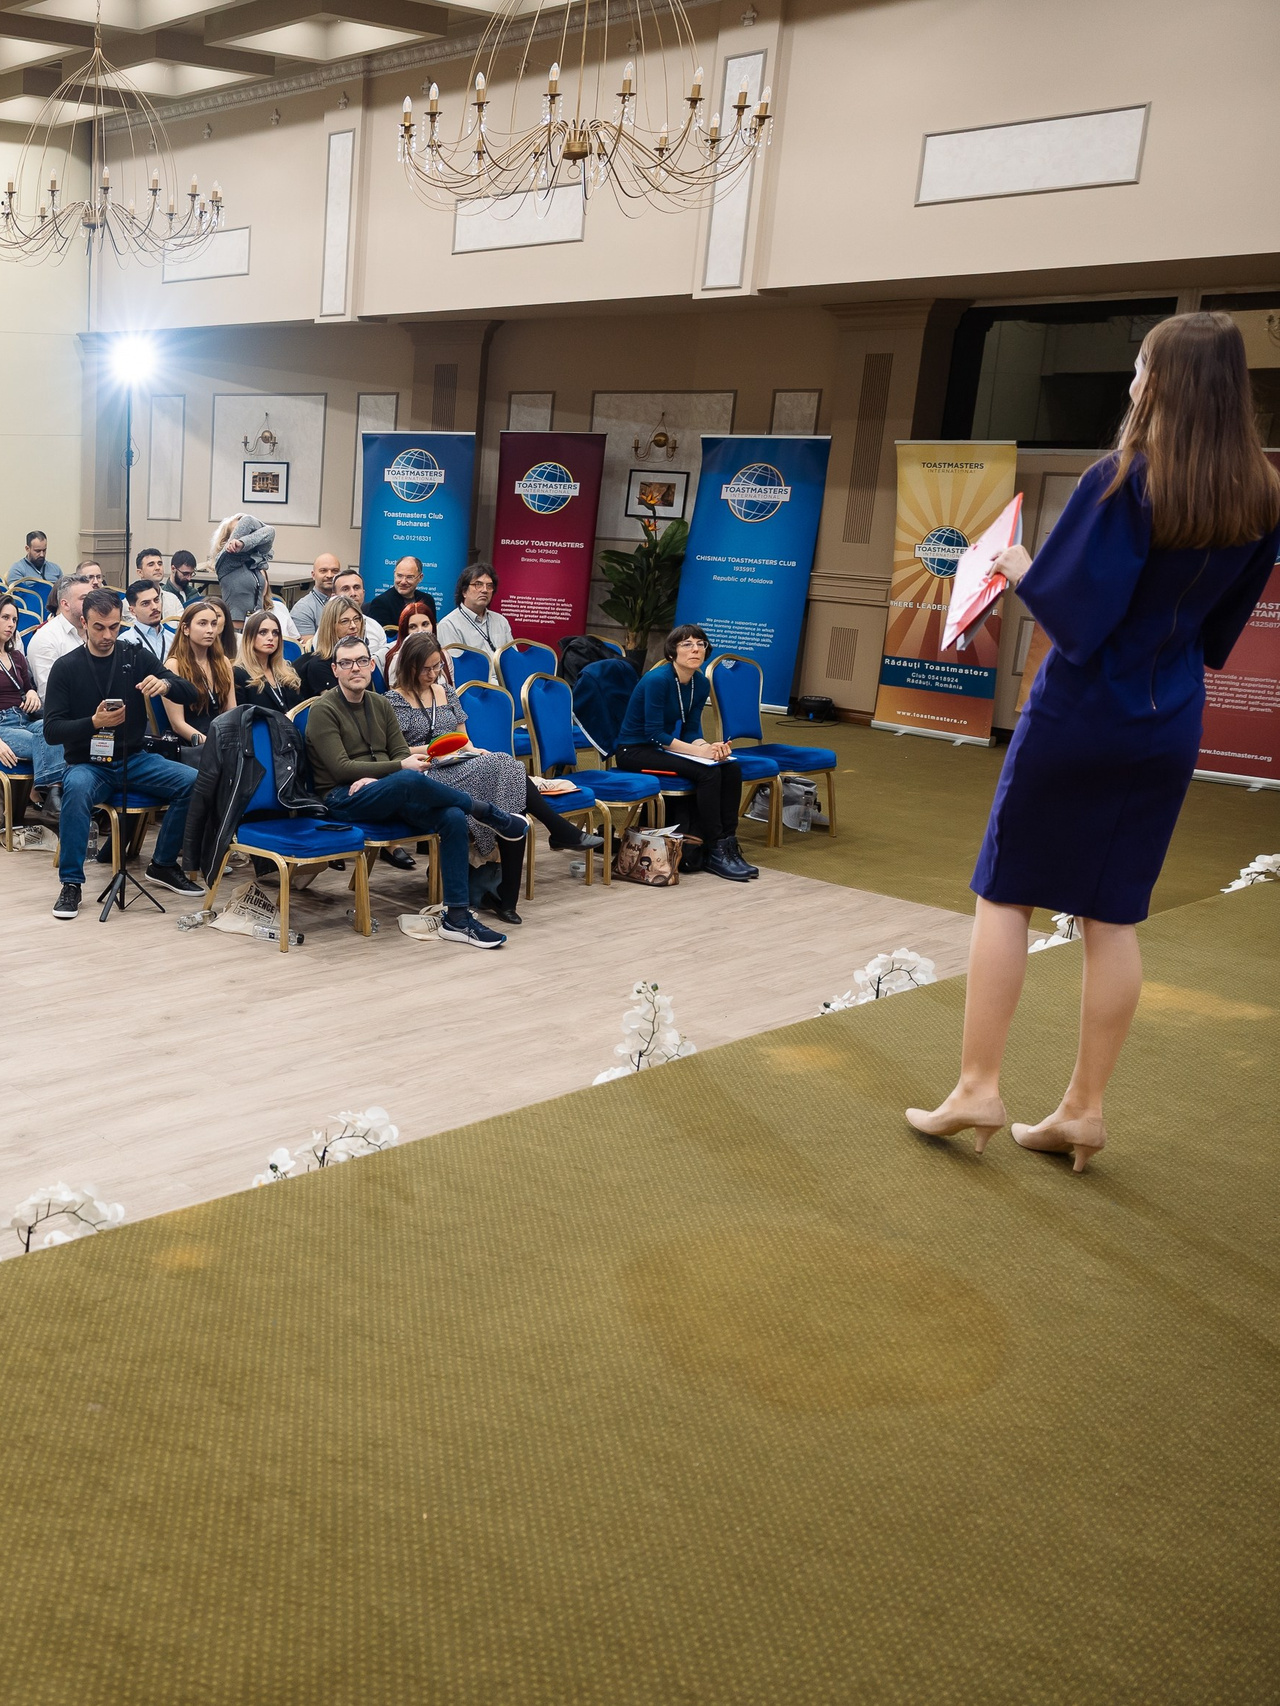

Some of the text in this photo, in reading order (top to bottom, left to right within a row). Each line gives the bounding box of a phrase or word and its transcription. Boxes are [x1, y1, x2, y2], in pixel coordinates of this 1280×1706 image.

[725, 487, 788, 495] TOASTMASTERS
[531, 540, 584, 548] TOASTMASTERS
[918, 546, 968, 554] TOASTMASTE
[728, 557, 778, 565] TOASTMASTERS
[917, 603, 950, 611] LEADER
[924, 663, 989, 677] Toastmasters
[928, 674, 958, 683] 05418924
[896, 710, 968, 725] www.toastmasters.ro
